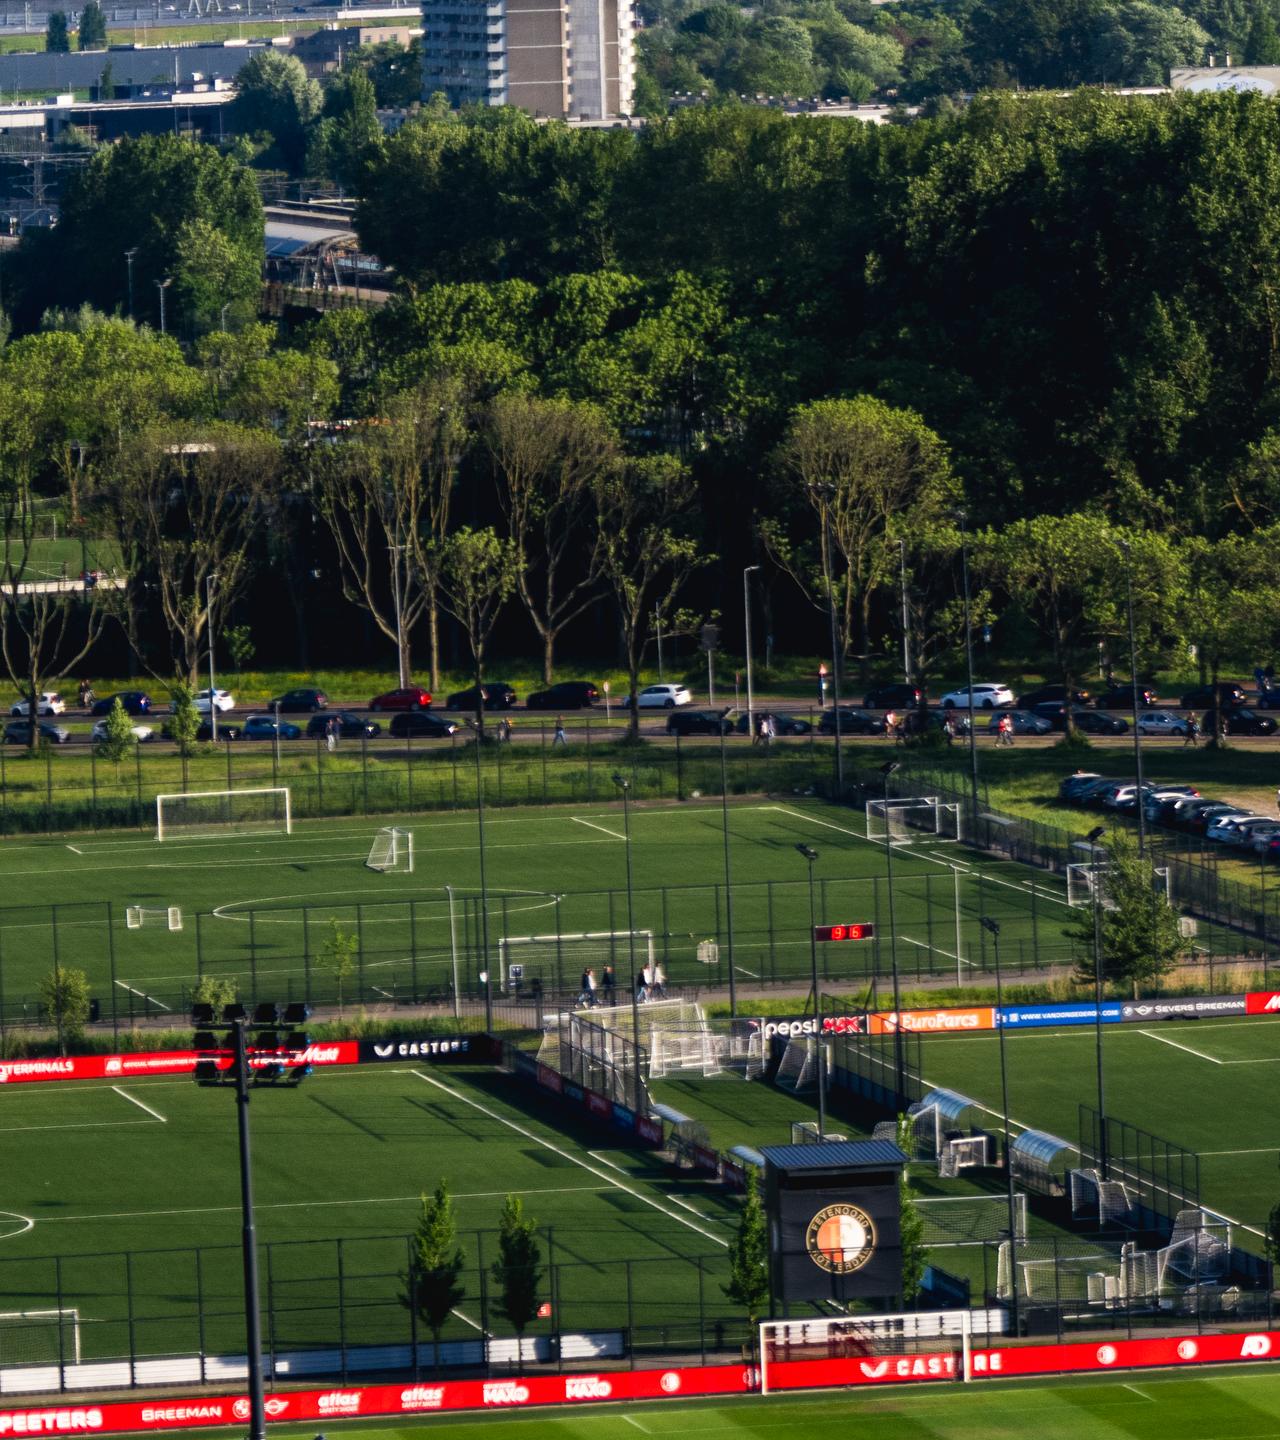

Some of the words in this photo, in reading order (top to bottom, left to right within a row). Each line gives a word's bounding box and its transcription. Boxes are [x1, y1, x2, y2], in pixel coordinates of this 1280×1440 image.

[1155, 1003, 1194, 1014] SEVERS
[1196, 1000, 1245, 1011] BREEMAN
[766, 1018, 819, 1041] pepsi
[902, 1013, 978, 1032] EuroParcs
[399, 1041, 469, 1057] CASTORE
[811, 1207, 869, 1231] FEYENOORD
[1241, 1335, 1271, 1356] AD
[897, 1353, 1002, 1376] CASTRE
[318, 1391, 360, 1407] atlas
[402, 1386, 444, 1403] atlas
[0, 1409, 103, 1434] PEETERS
[142, 1405, 222, 1423] BREEMAN
